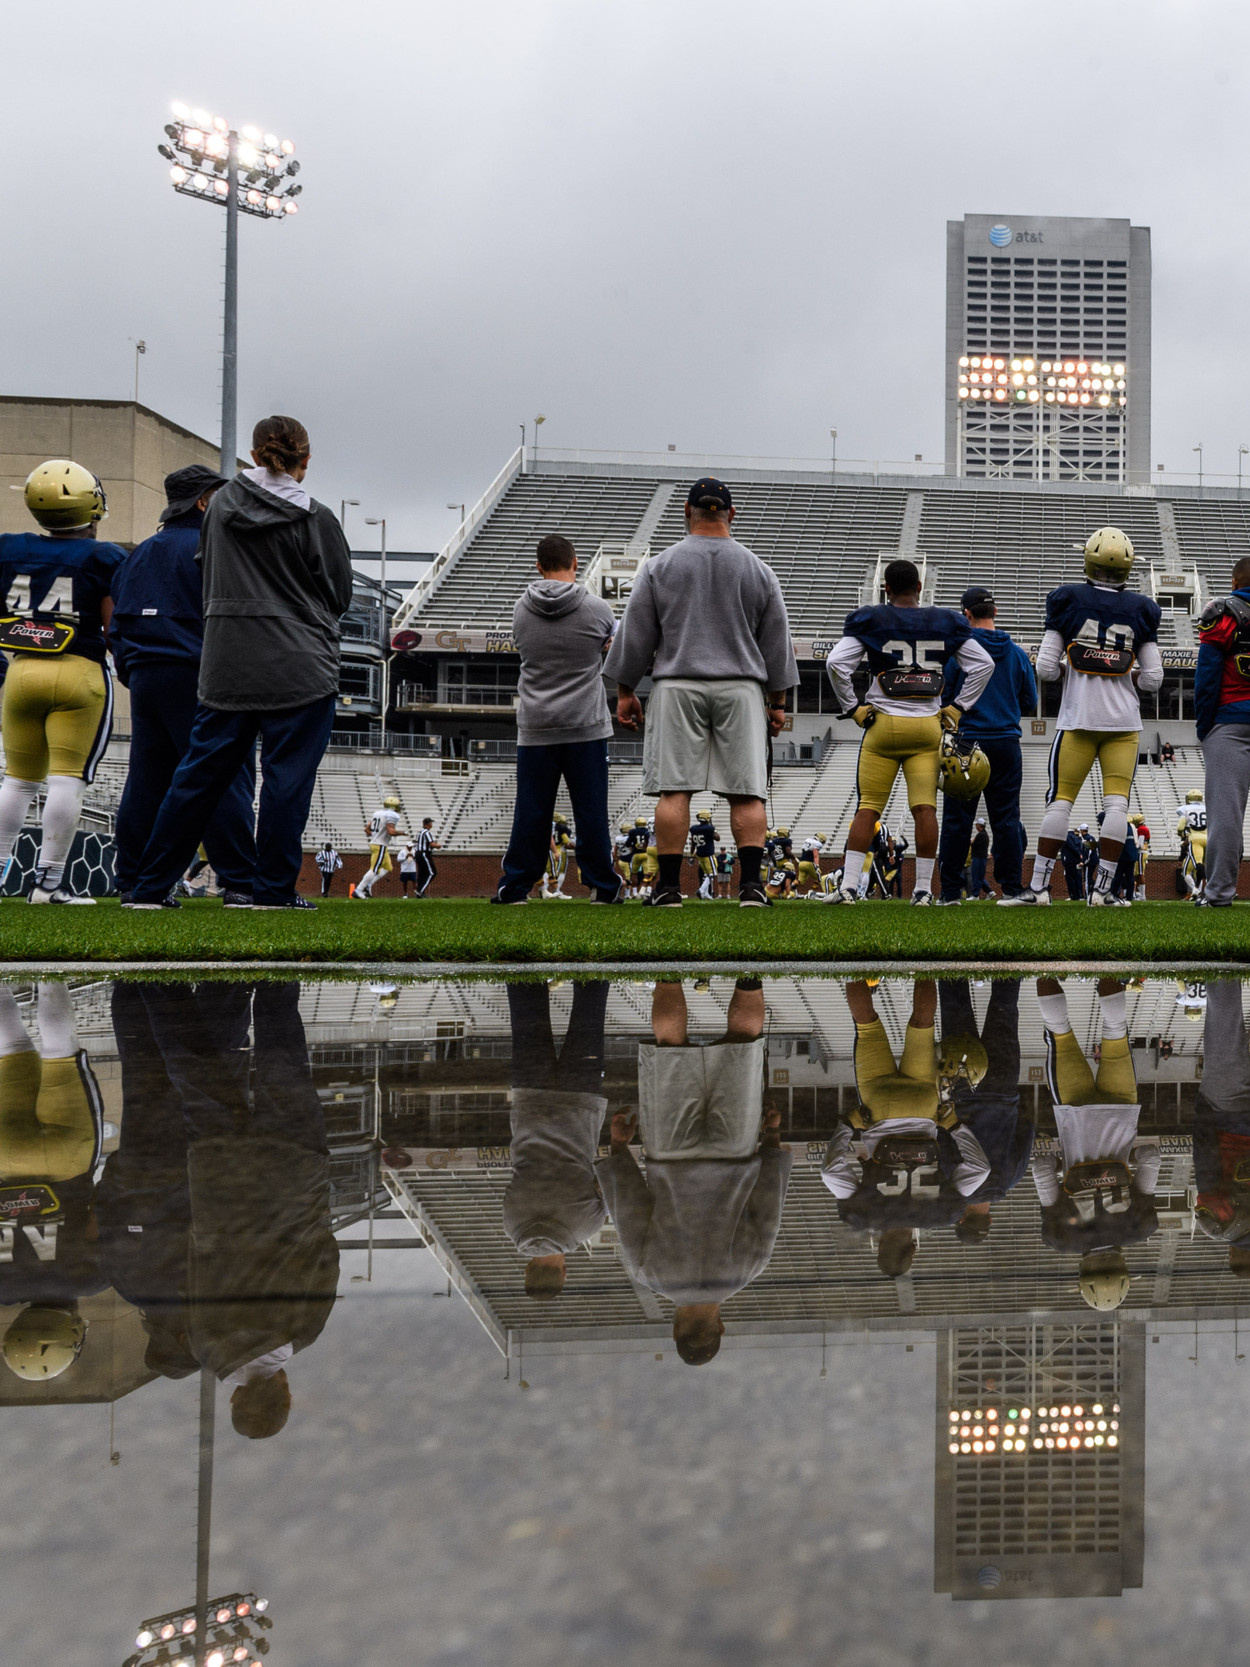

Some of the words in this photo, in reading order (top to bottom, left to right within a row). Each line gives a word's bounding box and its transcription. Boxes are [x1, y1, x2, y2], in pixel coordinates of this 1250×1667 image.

[1015, 231, 1044, 244] at&t
[9, 624, 54, 639] POWER
[1083, 649, 1121, 661] POWER
